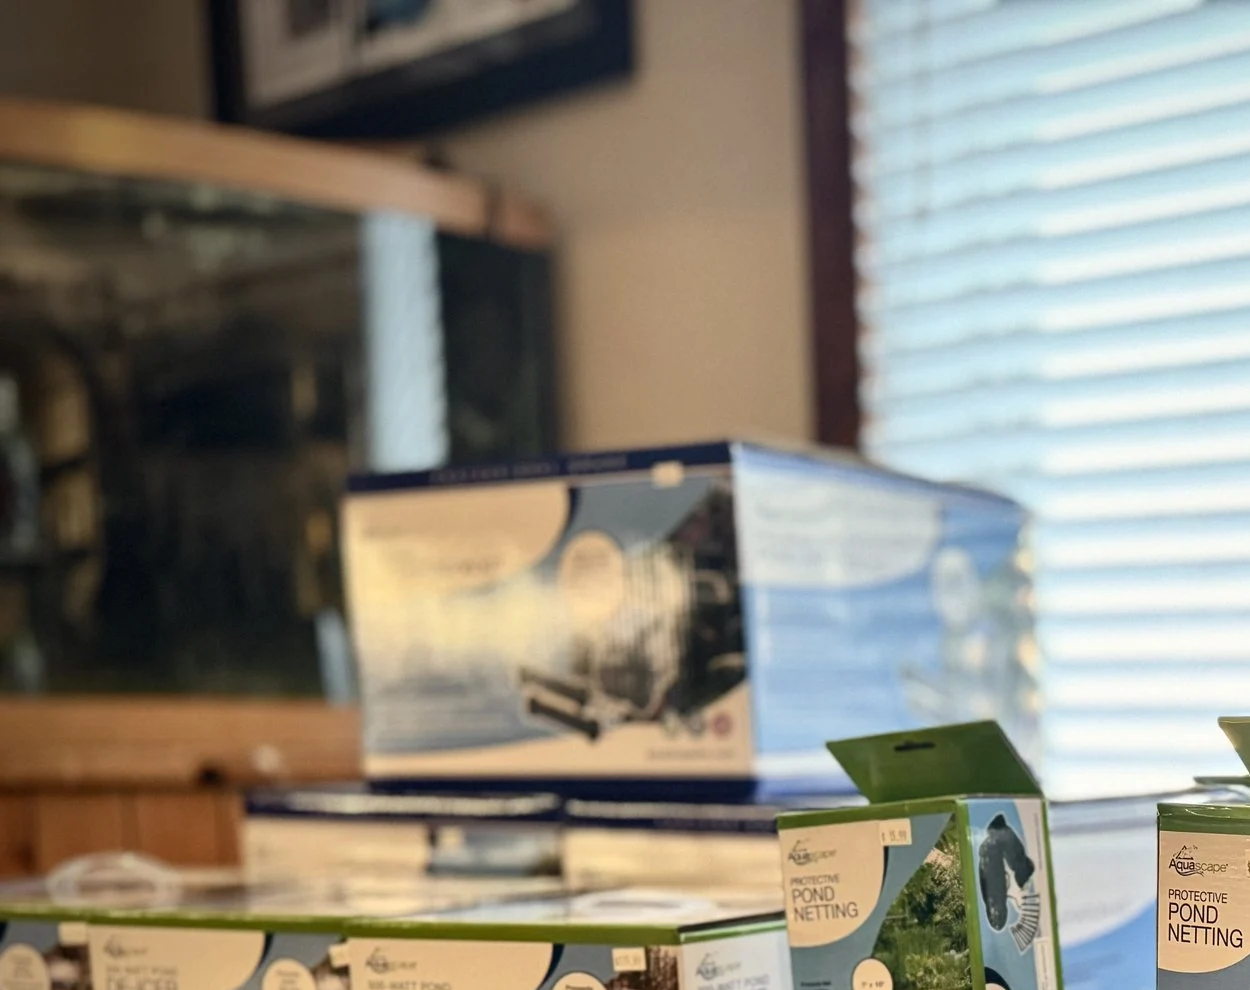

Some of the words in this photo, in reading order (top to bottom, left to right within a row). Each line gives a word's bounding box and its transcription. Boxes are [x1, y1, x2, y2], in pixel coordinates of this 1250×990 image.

[1168, 858, 1229, 874] Aquascape
[790, 873, 840, 886] PROTECTIVE
[791, 885, 835, 903] POND
[1168, 889, 1228, 904] PROTECTIVE
[793, 901, 859, 922] NETTING
[1168, 903, 1219, 924] POND
[1168, 924, 1244, 949] NETTING
